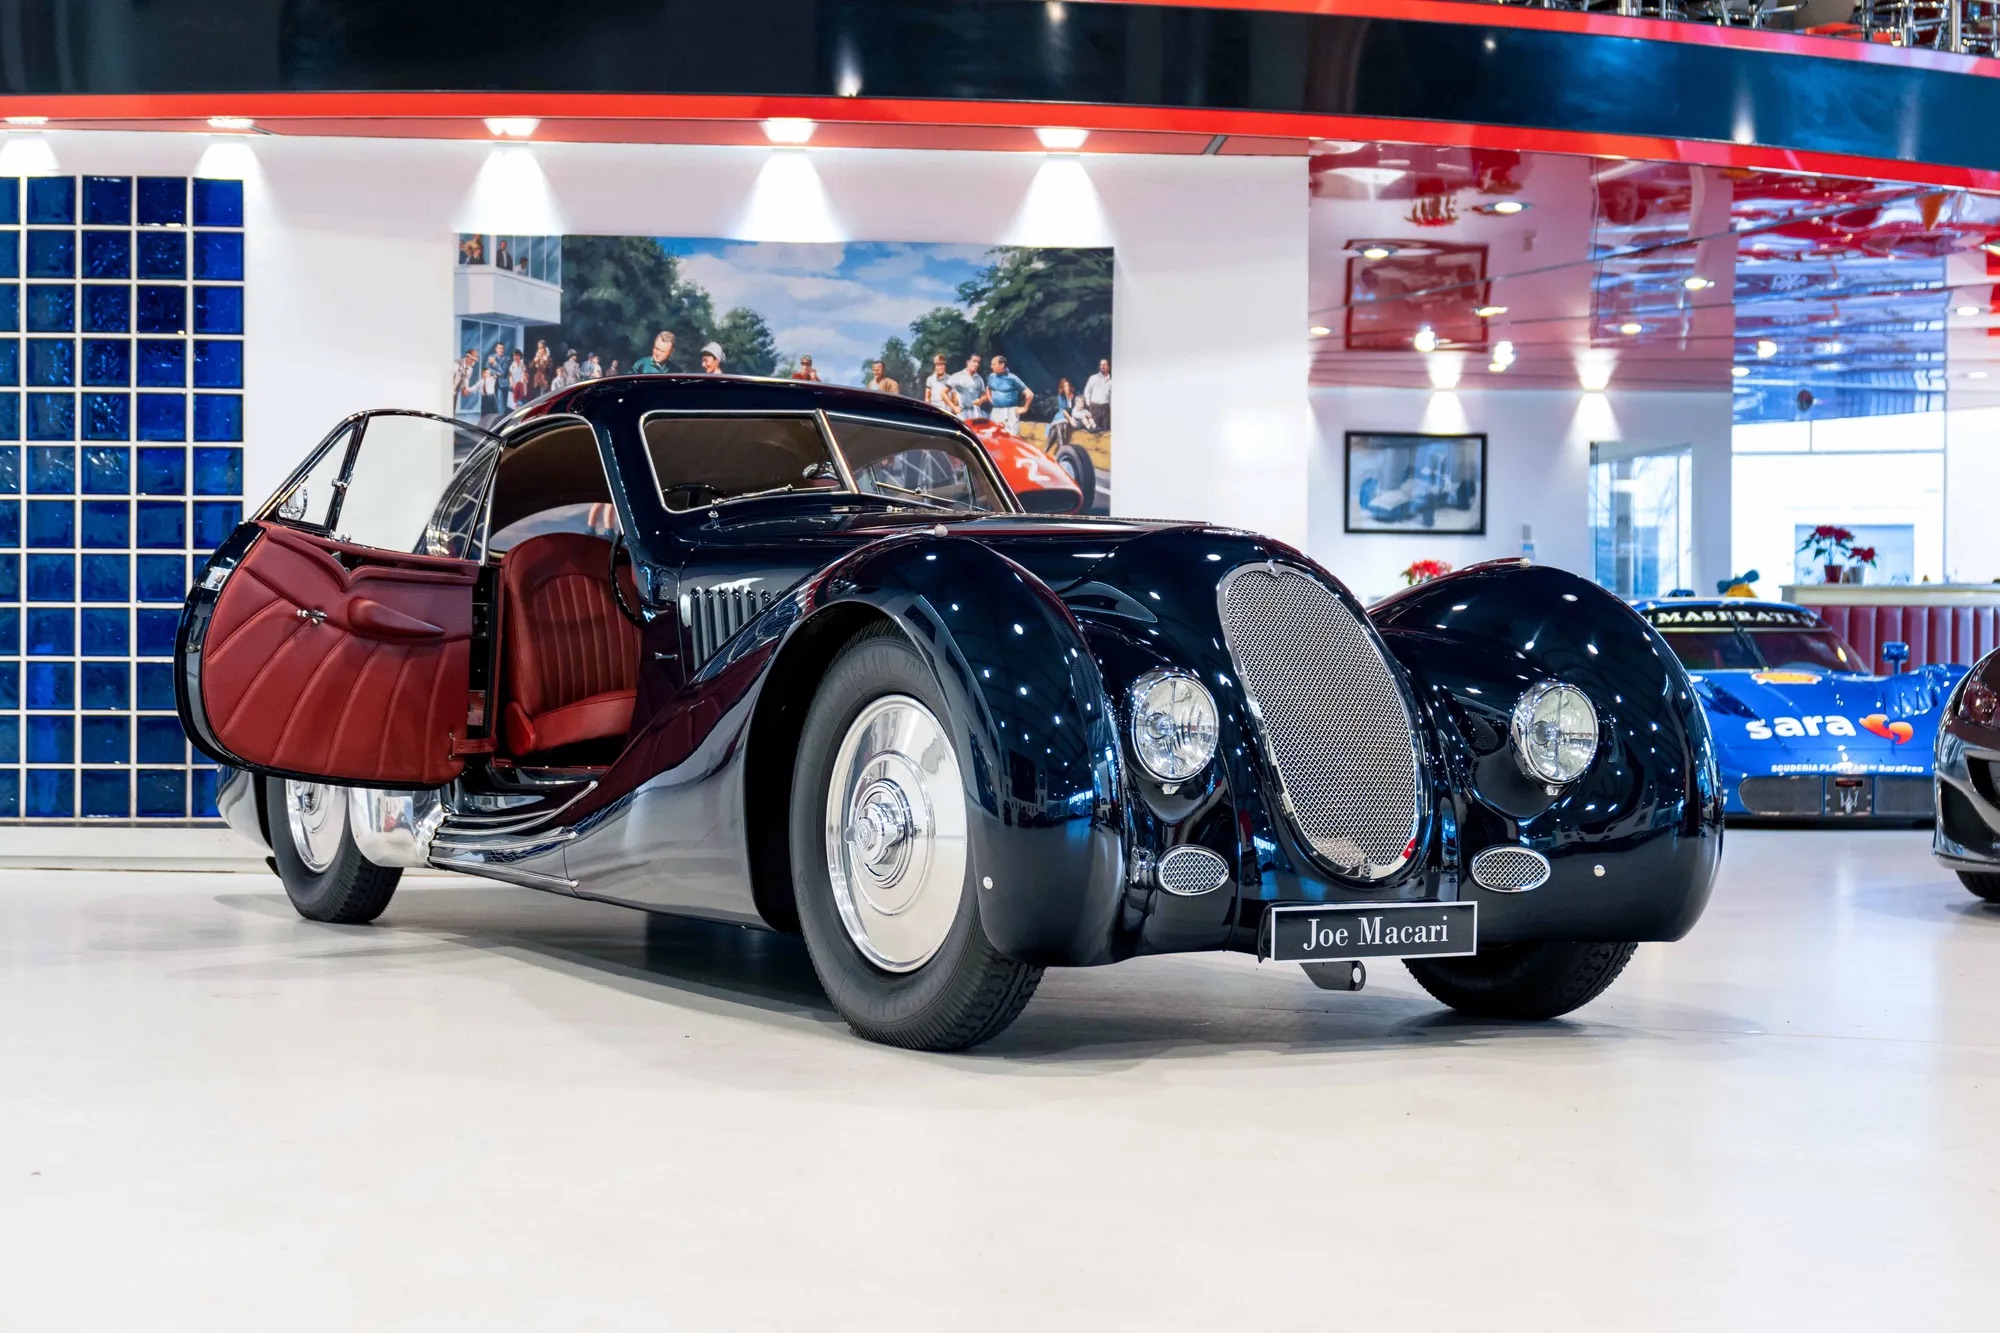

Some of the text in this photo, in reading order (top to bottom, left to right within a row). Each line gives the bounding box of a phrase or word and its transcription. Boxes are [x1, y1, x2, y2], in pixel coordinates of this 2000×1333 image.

[1015, 457, 1051, 481] 2
[1745, 715, 1857, 740] sara
[1771, 764, 1818, 773] SCUDERIA
[1819, 763, 1868, 773] PLAAM
[1303, 915, 1449, 950] Joe Macari
